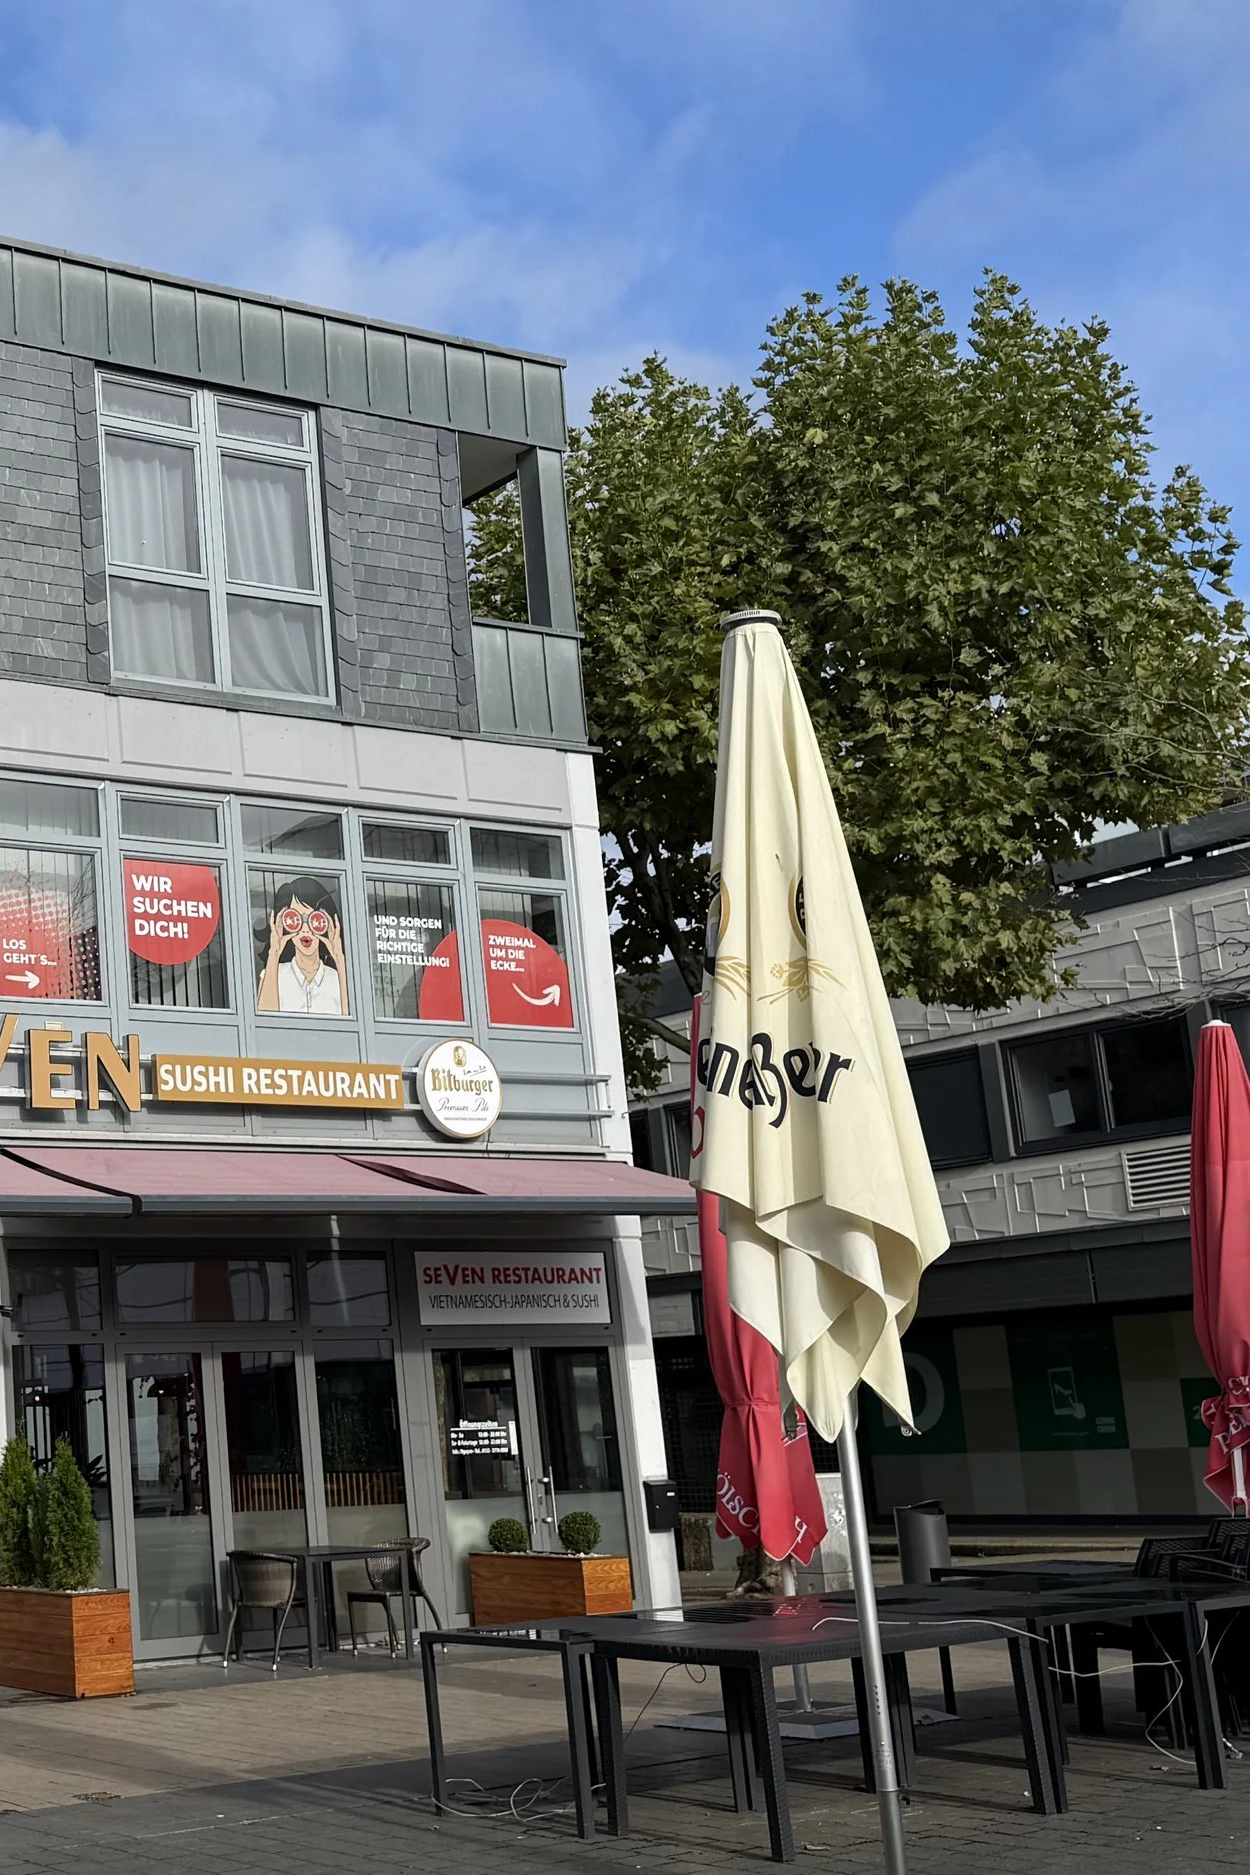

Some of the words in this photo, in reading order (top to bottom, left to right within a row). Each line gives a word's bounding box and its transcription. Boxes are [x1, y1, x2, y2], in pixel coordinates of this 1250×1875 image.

[131, 873, 173, 893] WIR
[132, 897, 213, 919] SUCHEN
[134, 918, 189, 939] DICH!
[374, 914, 397, 926] UND
[400, 916, 442, 929] SORGEN
[375, 926, 396, 939] FÜR
[398, 928, 417, 940] DIE
[2, 938, 27, 950] LOS
[376, 940, 425, 953] RICHTIGE
[488, 934, 537, 948] ZWEIMAL
[378, 953, 451, 968] EINSTELLUNG!
[489, 947, 507, 959] UM
[508, 948, 526, 960] DIE
[159, 1062, 235, 1093] SUSHI
[242, 1069, 400, 1100] RESTAURANT
[430, 1068, 494, 1096] Bitburger
[422, 1264, 485, 1287] SEVEN
[491, 1267, 602, 1285] RESTAURANT
[429, 1293, 561, 1309] VIETNAMESISCH-JAPANISCH
[563, 1293, 570, 1309] &
[573, 1293, 600, 1309] SUSHI
